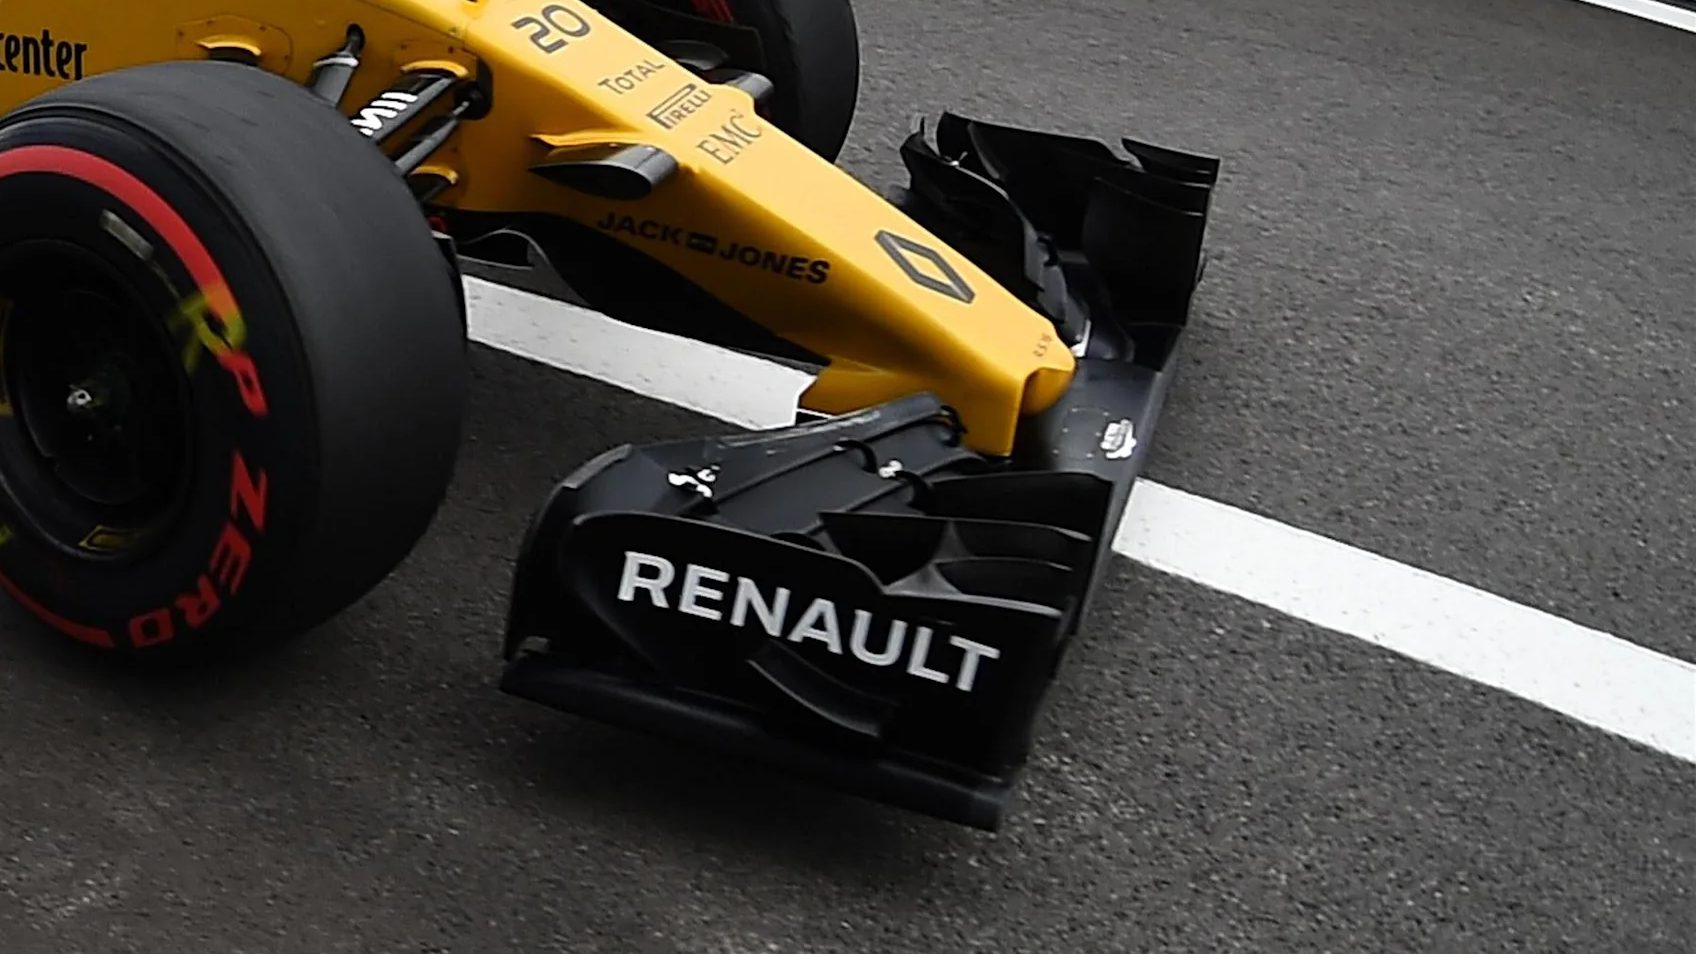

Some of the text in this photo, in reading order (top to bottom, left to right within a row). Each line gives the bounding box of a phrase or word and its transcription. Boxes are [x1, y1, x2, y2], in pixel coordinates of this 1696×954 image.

[510, 3, 591, 54] 20
[645, 83, 712, 130] PIRELLI
[596, 212, 831, 285] JACK JONES
[128, 449, 272, 648] ZERO
[616, 550, 1001, 693] RENAULT
